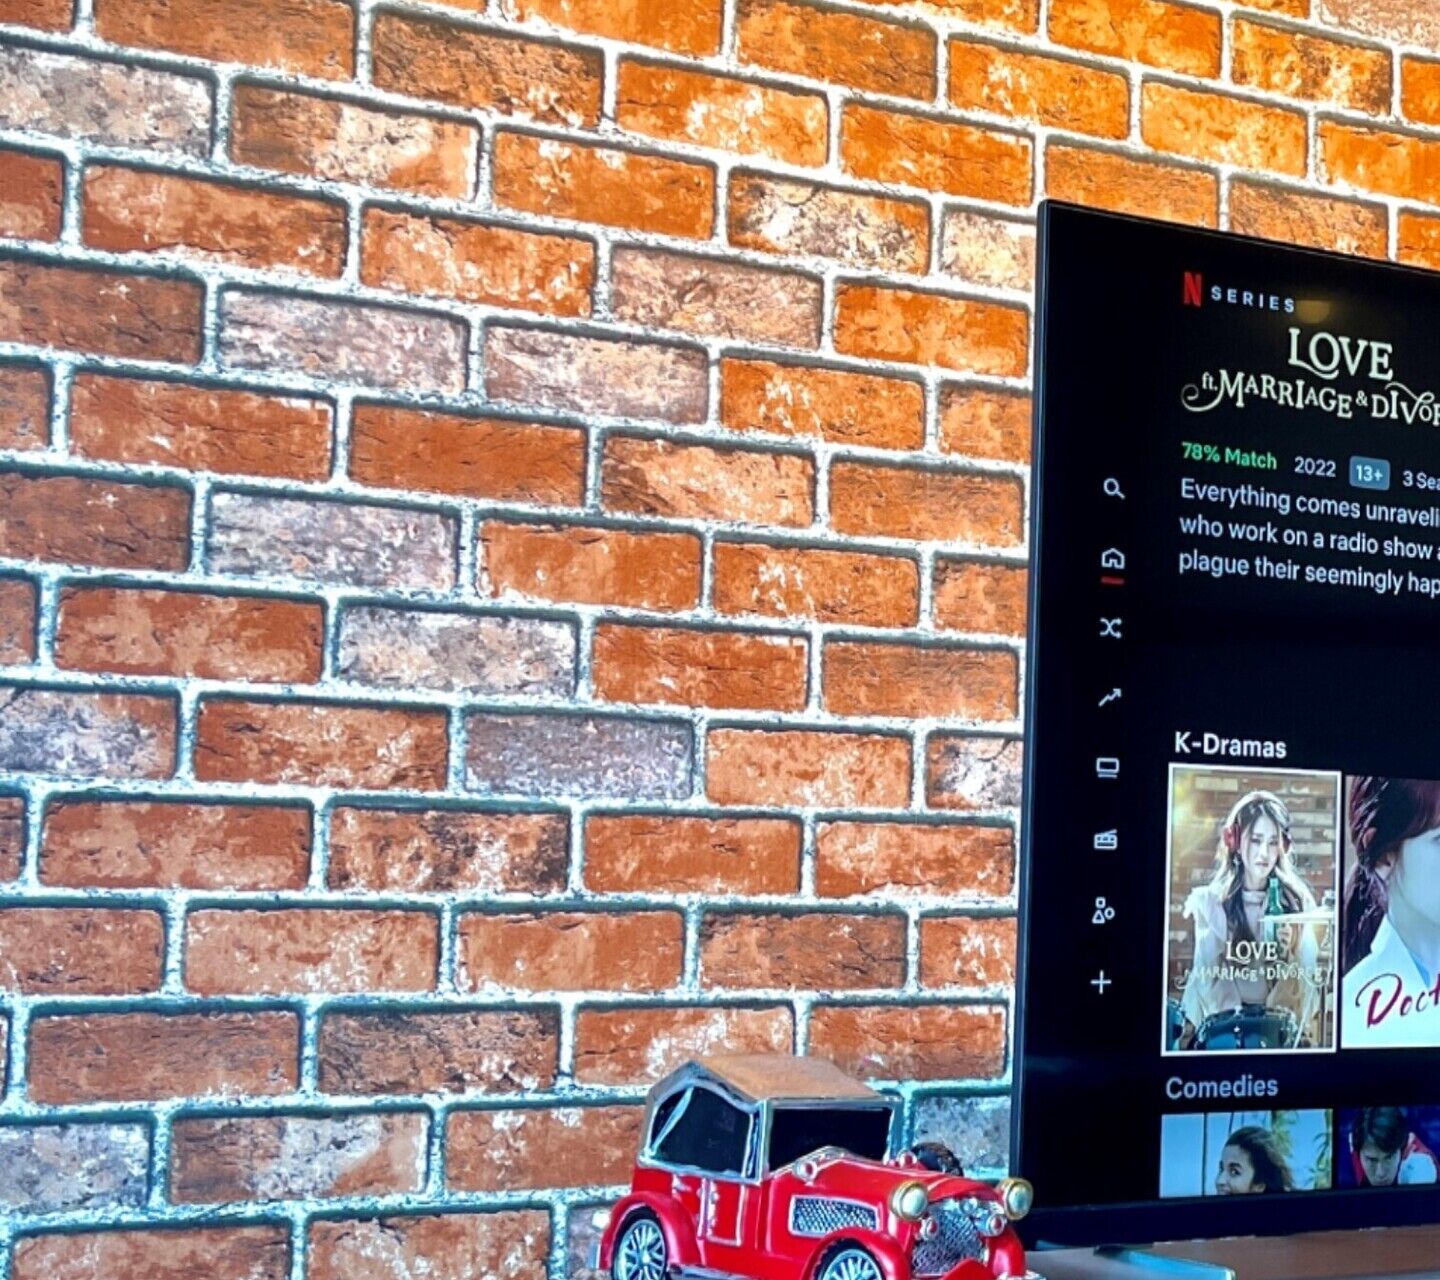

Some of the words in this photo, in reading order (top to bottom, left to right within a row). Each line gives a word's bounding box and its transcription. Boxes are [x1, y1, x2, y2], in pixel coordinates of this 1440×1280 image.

[1211, 285, 1295, 314] SERIES
[1288, 327, 1394, 380] LOVE
[1212, 369, 1353, 419] MARRIAGE
[1355, 390, 1369, 408] &
[1181, 441, 1221, 463] 78%
[1224, 446, 1278, 471] Match
[1294, 456, 1336, 478] 2022
[1355, 464, 1383, 483] 13+
[1403, 470, 1413, 487] 3
[1180, 476, 1291, 516] Everything
[1295, 496, 1361, 519] comes
[1179, 513, 1224, 539] who
[1228, 521, 1279, 544] work
[1283, 528, 1309, 548] on
[1312, 532, 1325, 549] a
[1329, 531, 1380, 556] radio
[1383, 535, 1434, 561] show
[1179, 548, 1251, 578] plague
[1254, 556, 1301, 581] their
[1304, 566, 1404, 597] seemingly
[1174, 729, 1288, 760] K-Dramas
[1225, 940, 1279, 964] LOVE
[1164, 1074, 1280, 1102] Comedies
